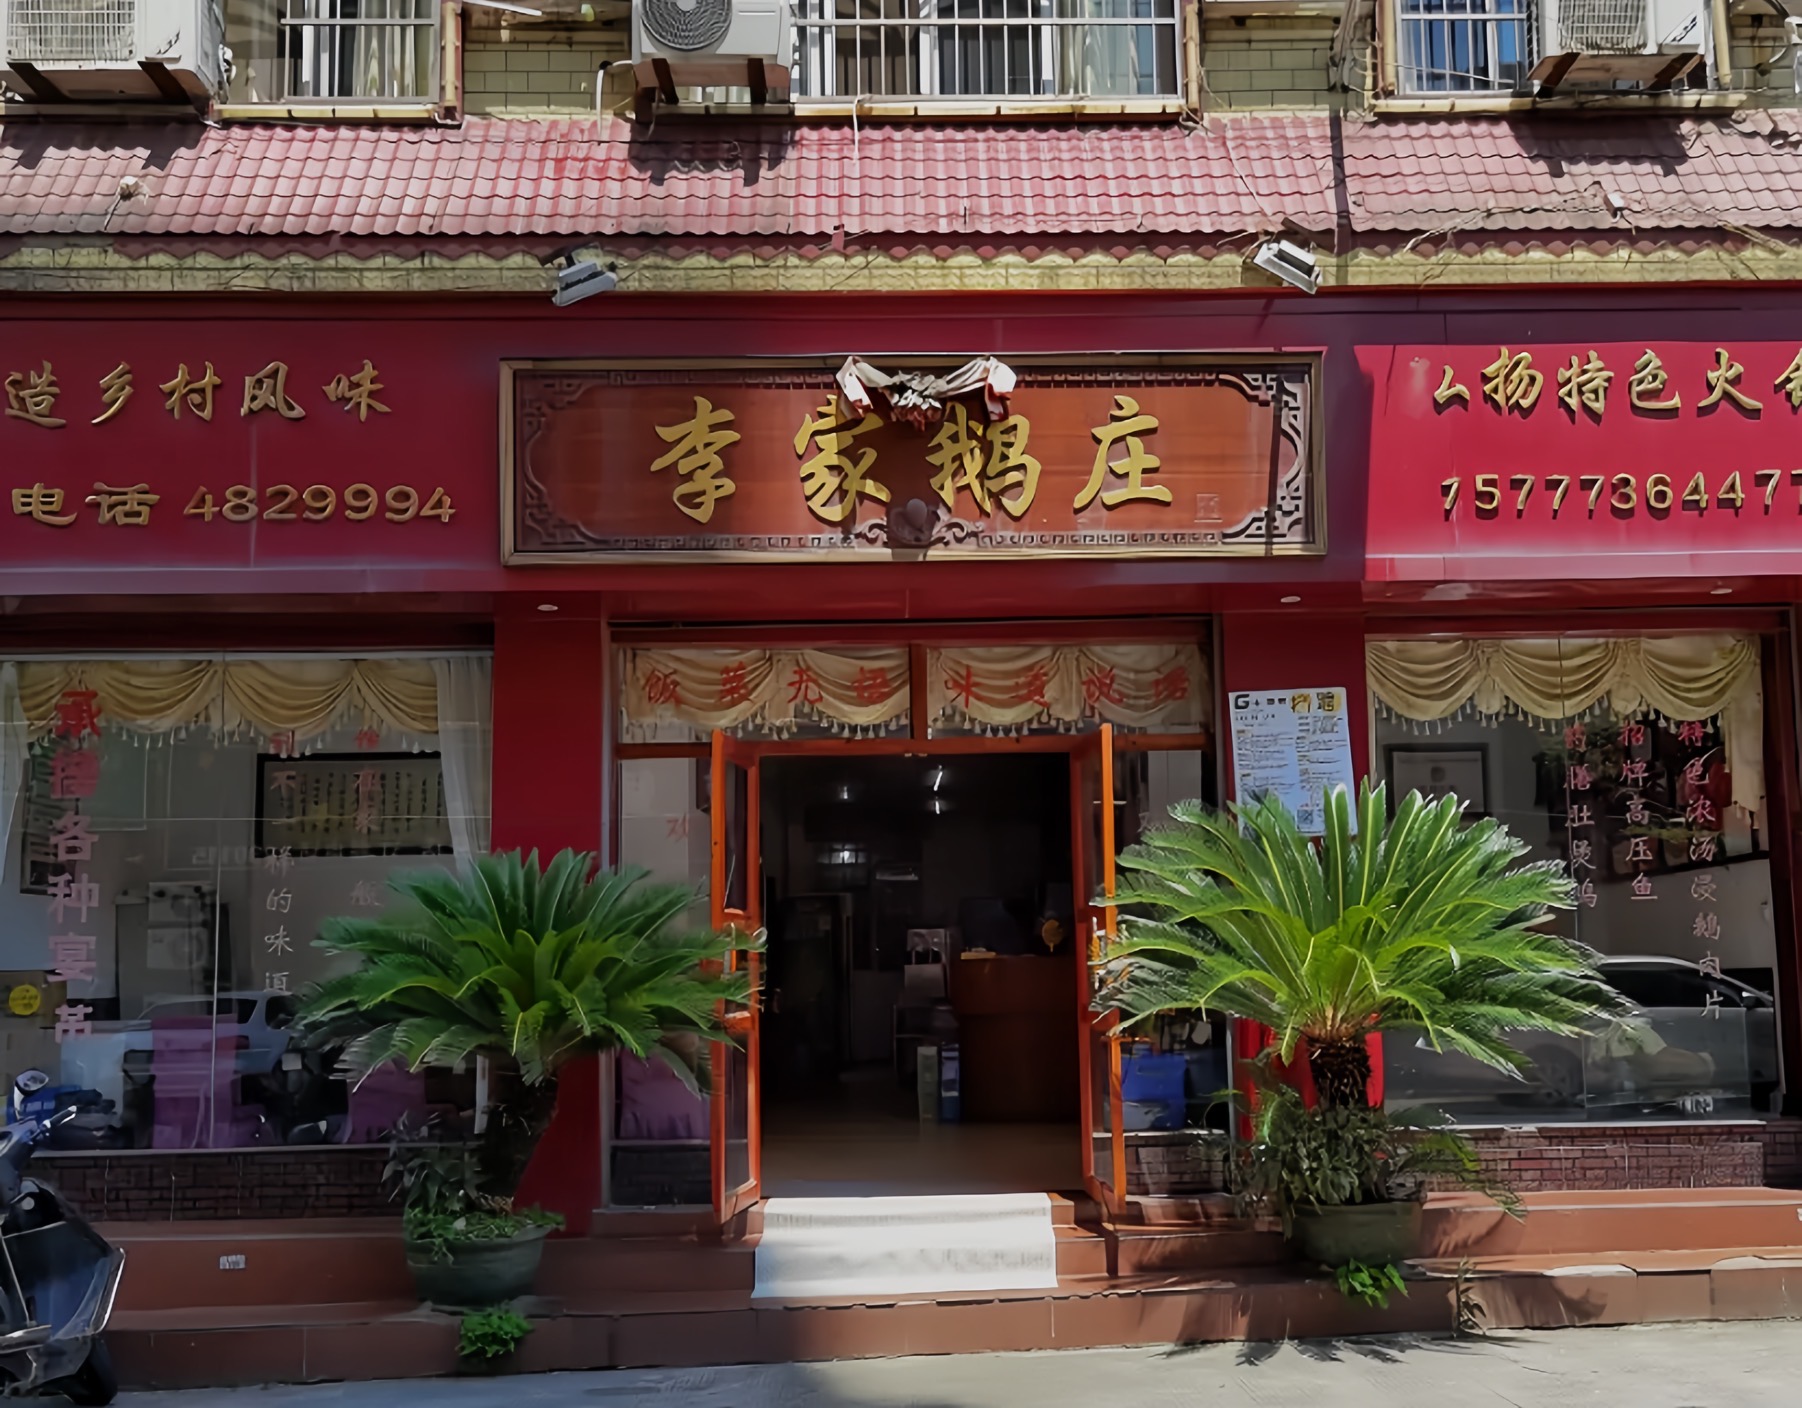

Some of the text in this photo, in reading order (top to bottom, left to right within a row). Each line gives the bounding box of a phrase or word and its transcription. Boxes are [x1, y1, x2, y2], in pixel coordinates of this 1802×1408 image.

[4, 359, 392, 428] 造乡村风味
[650, 395, 1173, 523] 李家鹅庄
[1618, 721, 1658, 900] 招牌高压鱼
